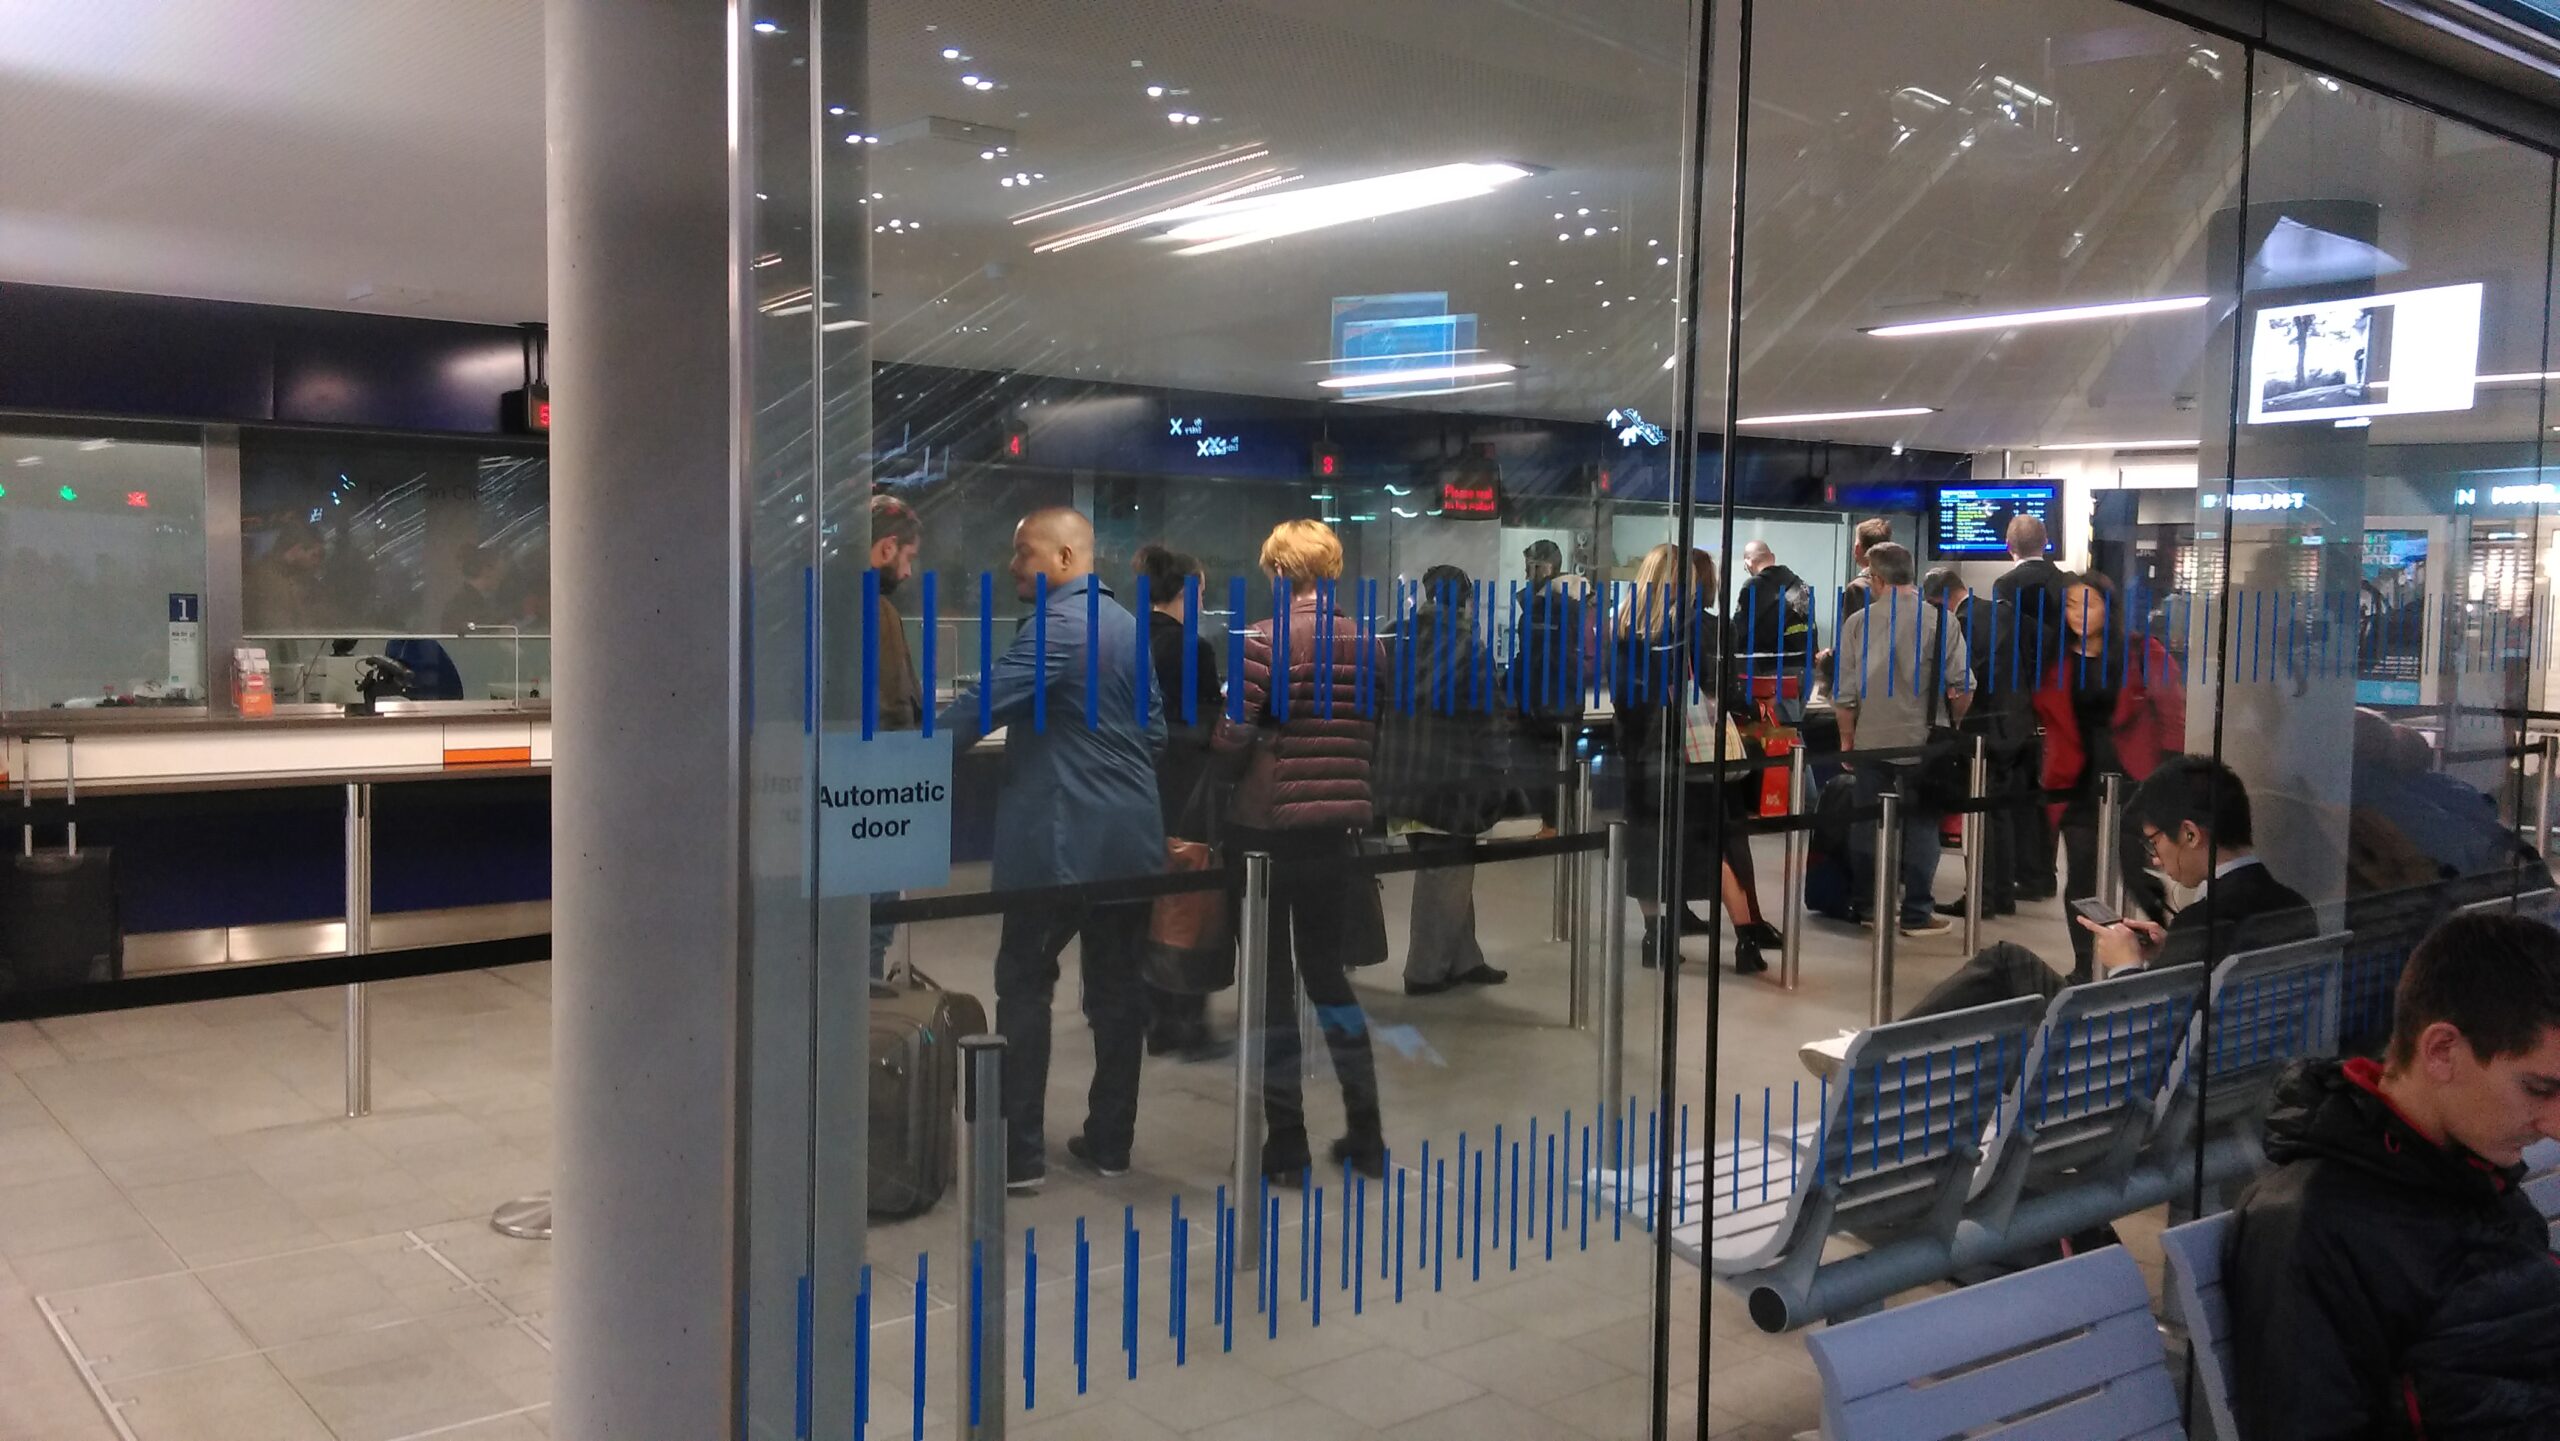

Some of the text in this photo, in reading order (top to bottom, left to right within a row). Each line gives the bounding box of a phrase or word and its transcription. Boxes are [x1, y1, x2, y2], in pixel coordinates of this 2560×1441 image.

[1010, 435, 1020, 453] 4
[1323, 455, 1333, 473] 3
[1827, 485, 1834, 501] 1
[177, 599, 190, 621] 1
[820, 780, 946, 808] Automatic
[851, 816, 912, 840] door
